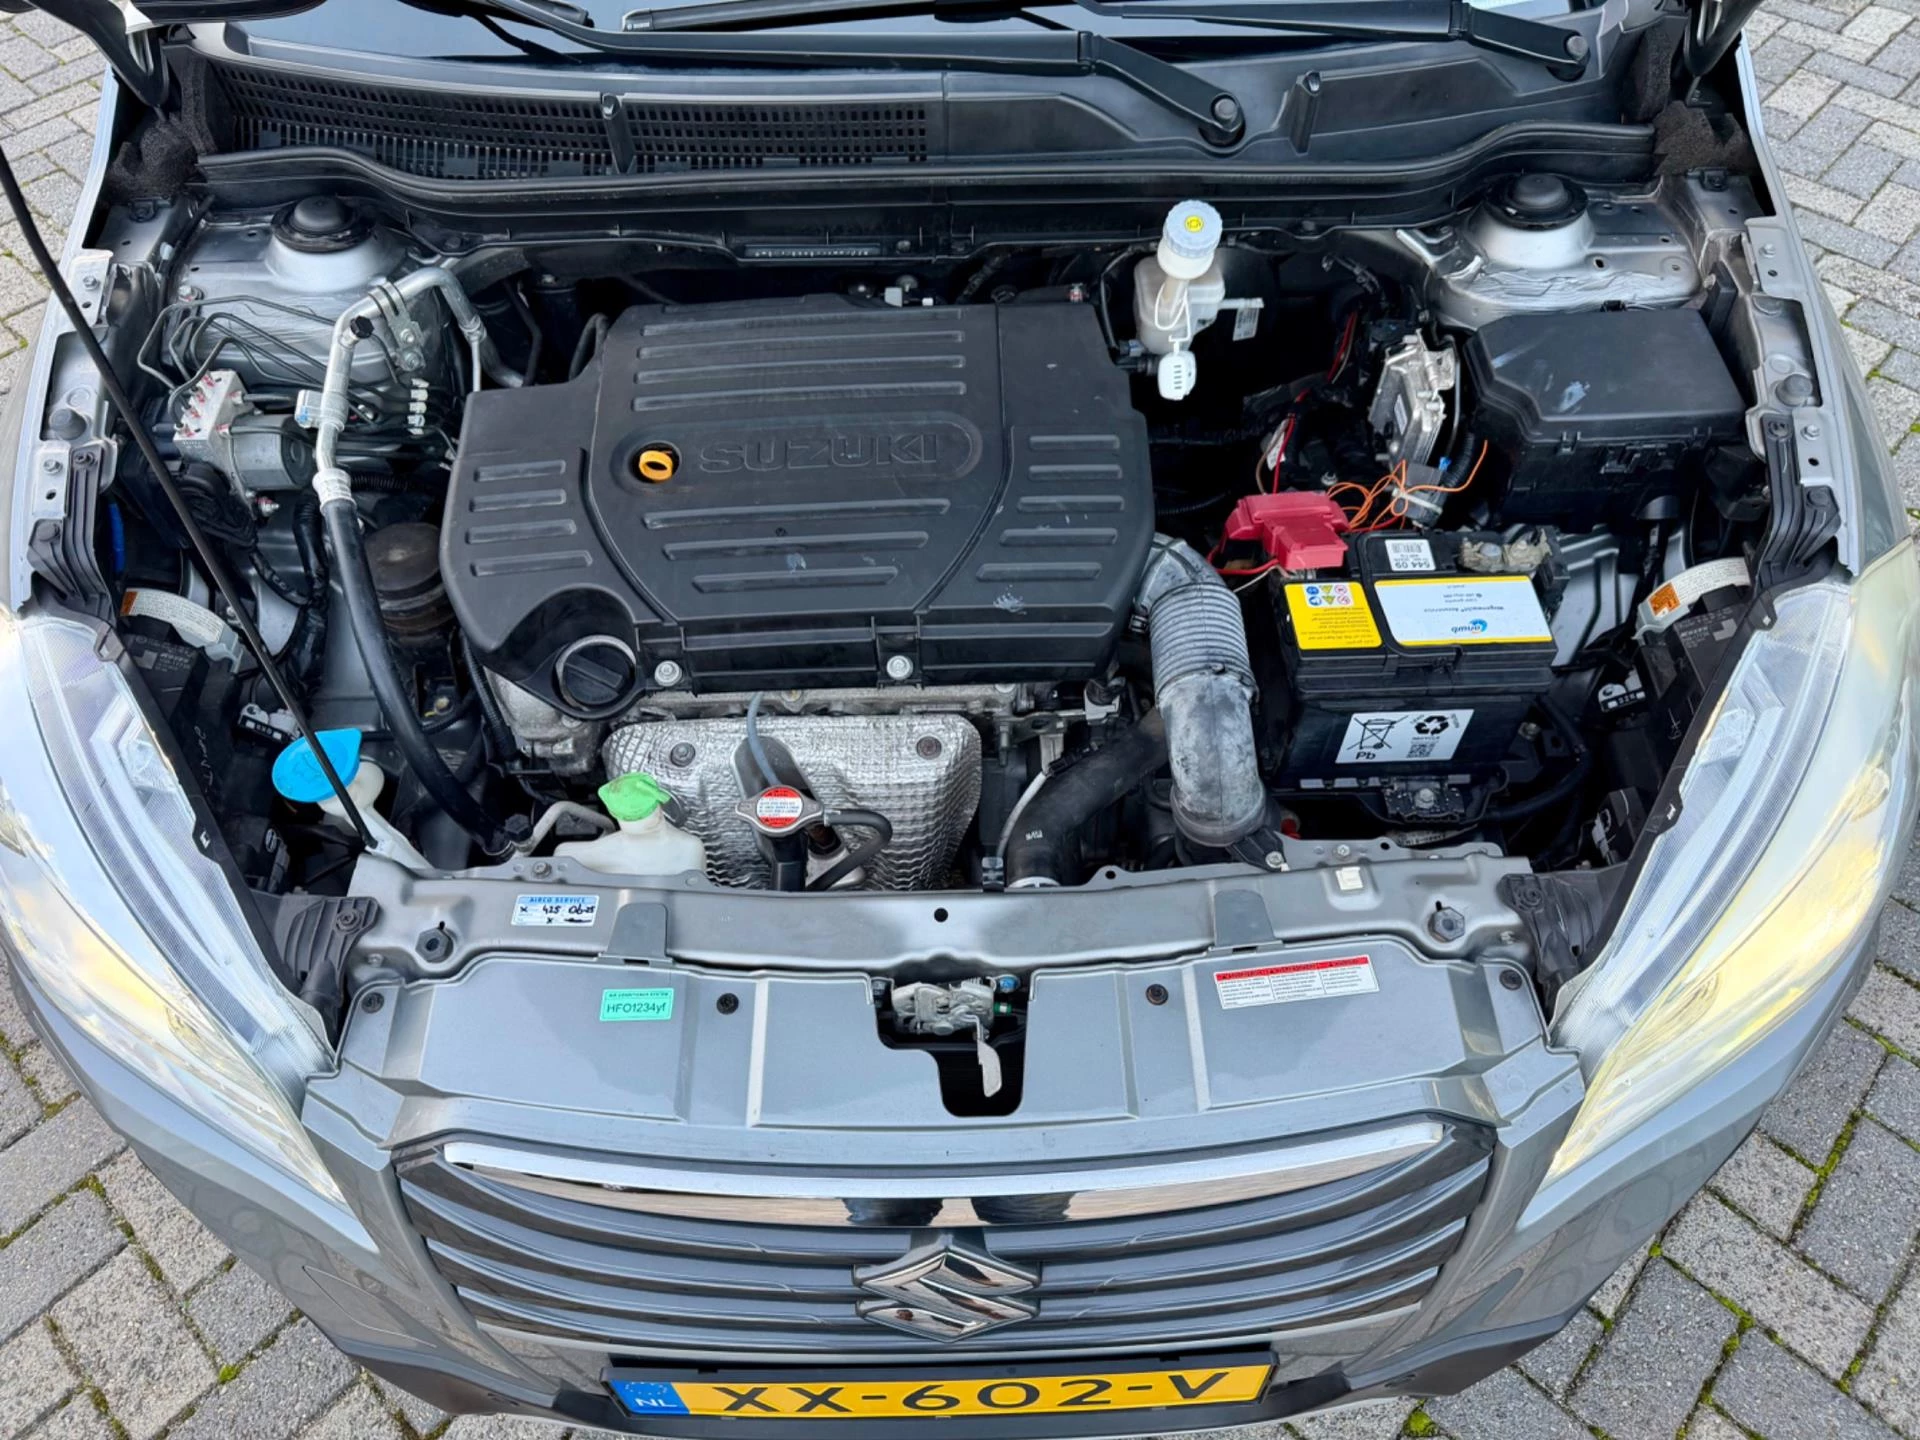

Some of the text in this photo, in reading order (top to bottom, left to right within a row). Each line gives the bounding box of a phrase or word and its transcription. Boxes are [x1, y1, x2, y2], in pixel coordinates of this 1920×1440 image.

[699, 434, 938, 474] SUZUKI
[1355, 751, 1377, 760] Pb
[529, 896, 586, 904] AIRCO SERVICE
[606, 1002, 667, 1014] HFO1234yf
[711, 1371, 1231, 1413] XX-602-V
[634, 1398, 678, 1408] NL
